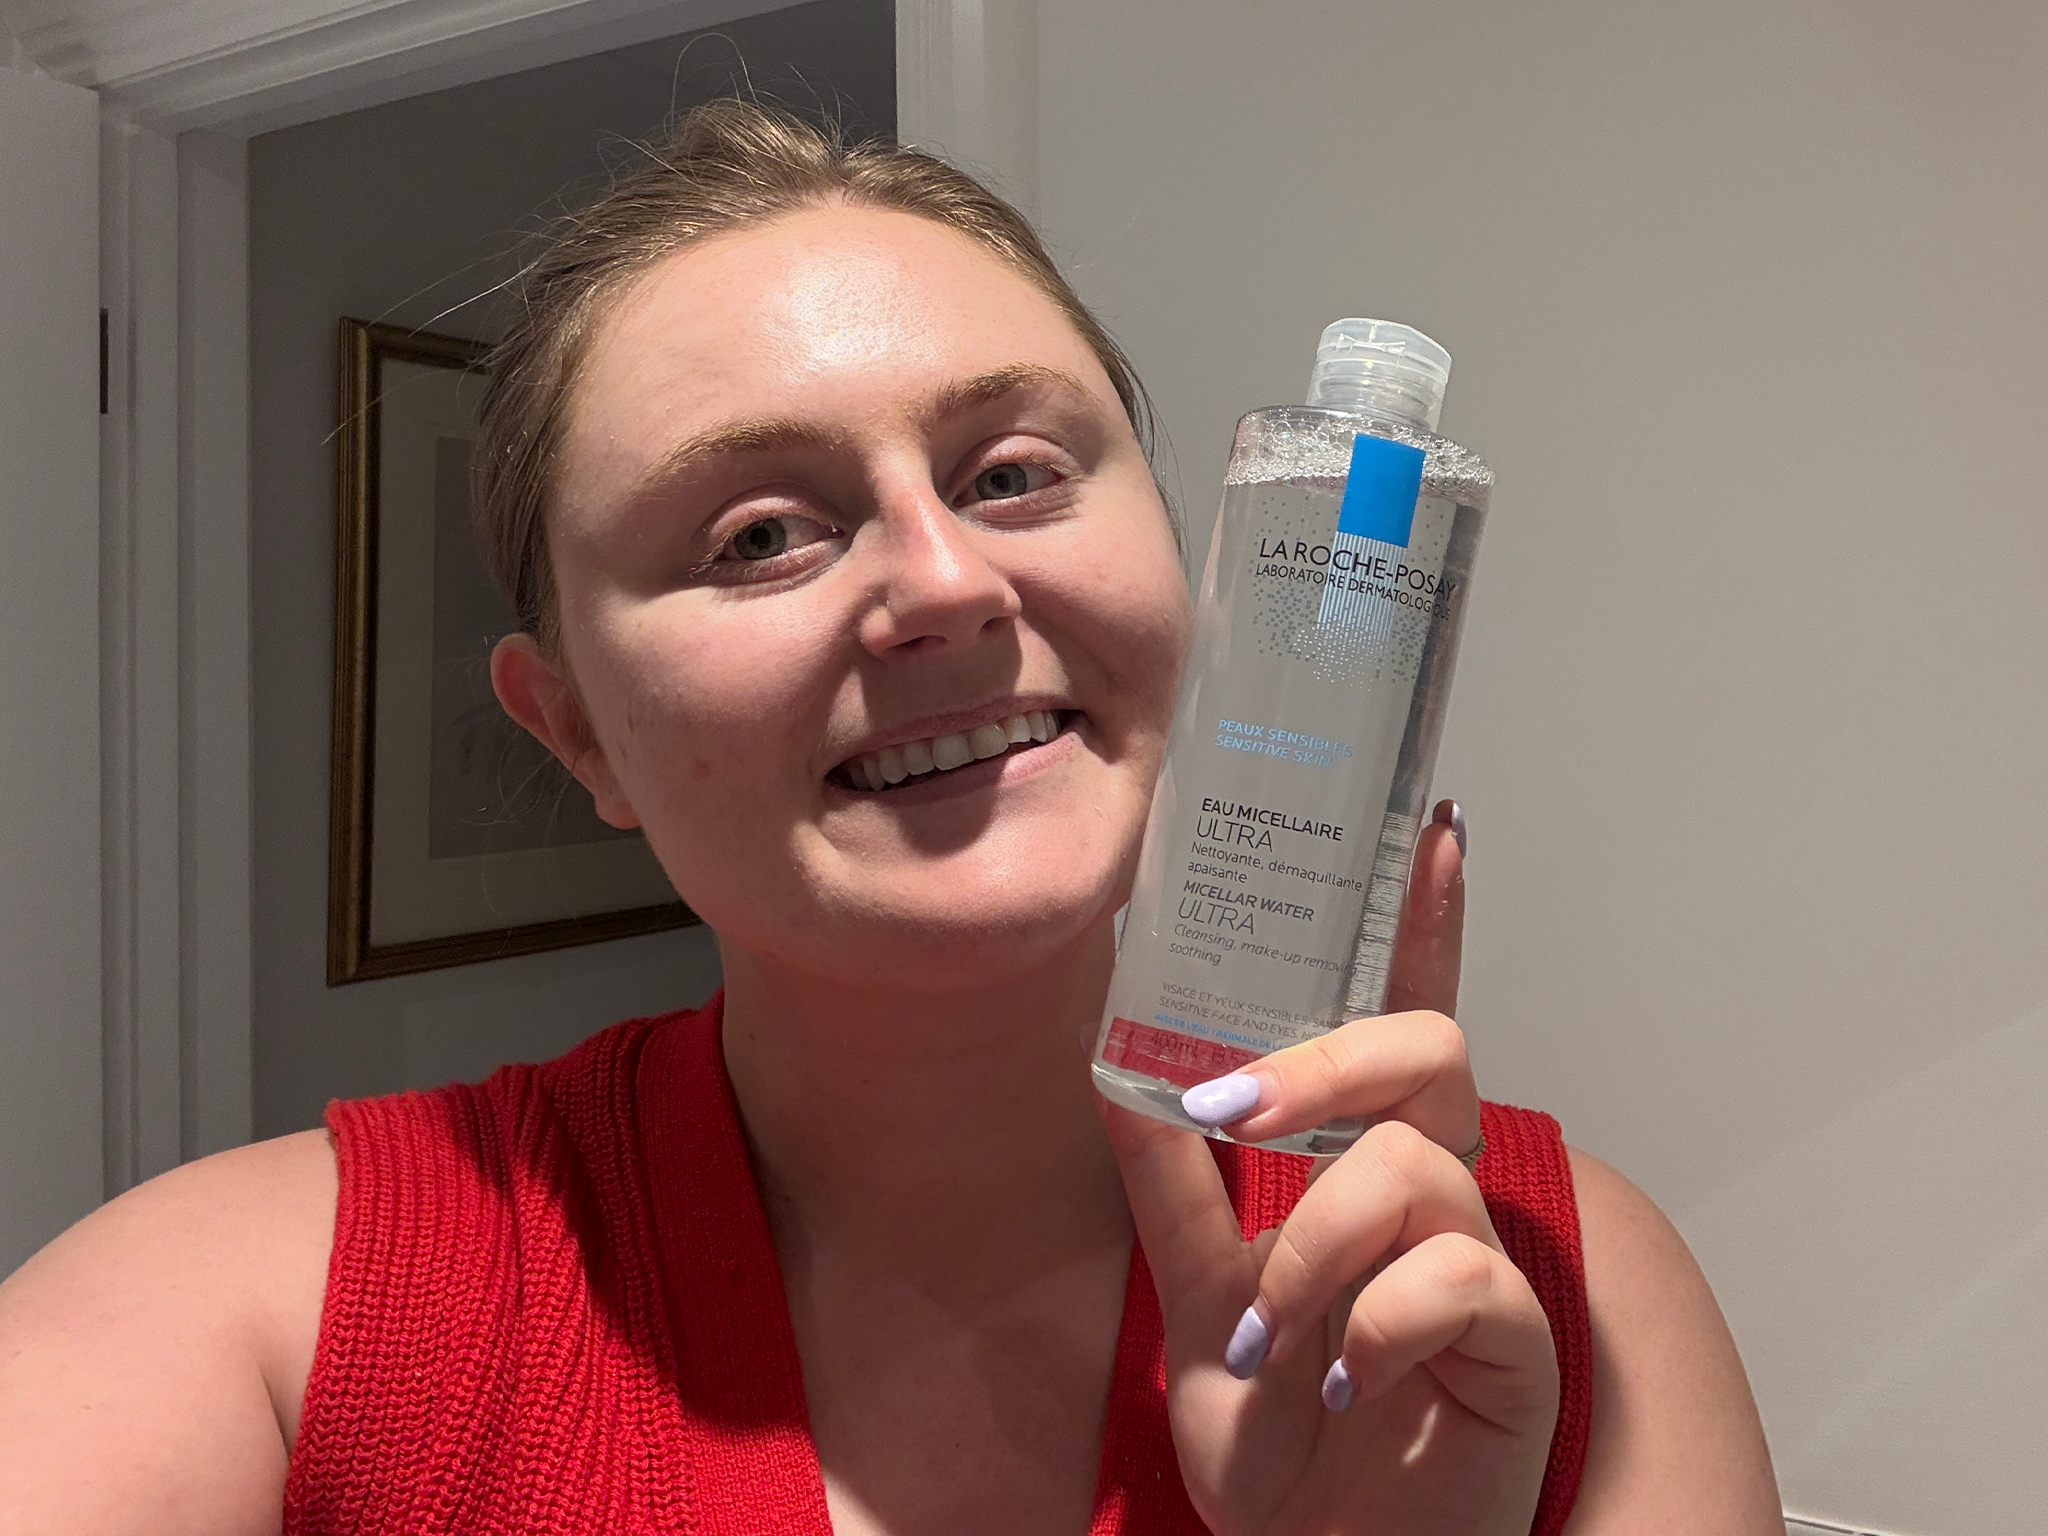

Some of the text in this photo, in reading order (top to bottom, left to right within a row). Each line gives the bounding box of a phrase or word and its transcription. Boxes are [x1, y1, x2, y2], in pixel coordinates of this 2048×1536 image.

[1256, 563, 1345, 589] LABORATOIRE
[1259, 538, 1456, 601] LA ROCHE-POSAY
[1215, 734, 1333, 768] SENSITIVE SKIN
[1218, 719, 1354, 758] PEAUX SENSIBLES
[1196, 815, 1273, 853] ULTRA
[1201, 798, 1344, 842] EAU MICELLAIRE
[1188, 861, 1248, 883] apaisante
[1178, 897, 1254, 935] ULTRA
[1183, 880, 1315, 921] MICELLAR WATER
[1168, 943, 1222, 966] soothing
[1241, 941, 1301, 965] make-up
[1158, 996, 1211, 1018] SENSITIVE
[1211, 1010, 1242, 1026] FACE
[1242, 1019, 1268, 1031] AND
[1163, 982, 1198, 999] VISAGE
[1199, 991, 1213, 1003] ET
[1214, 996, 1245, 1011] YEUX
